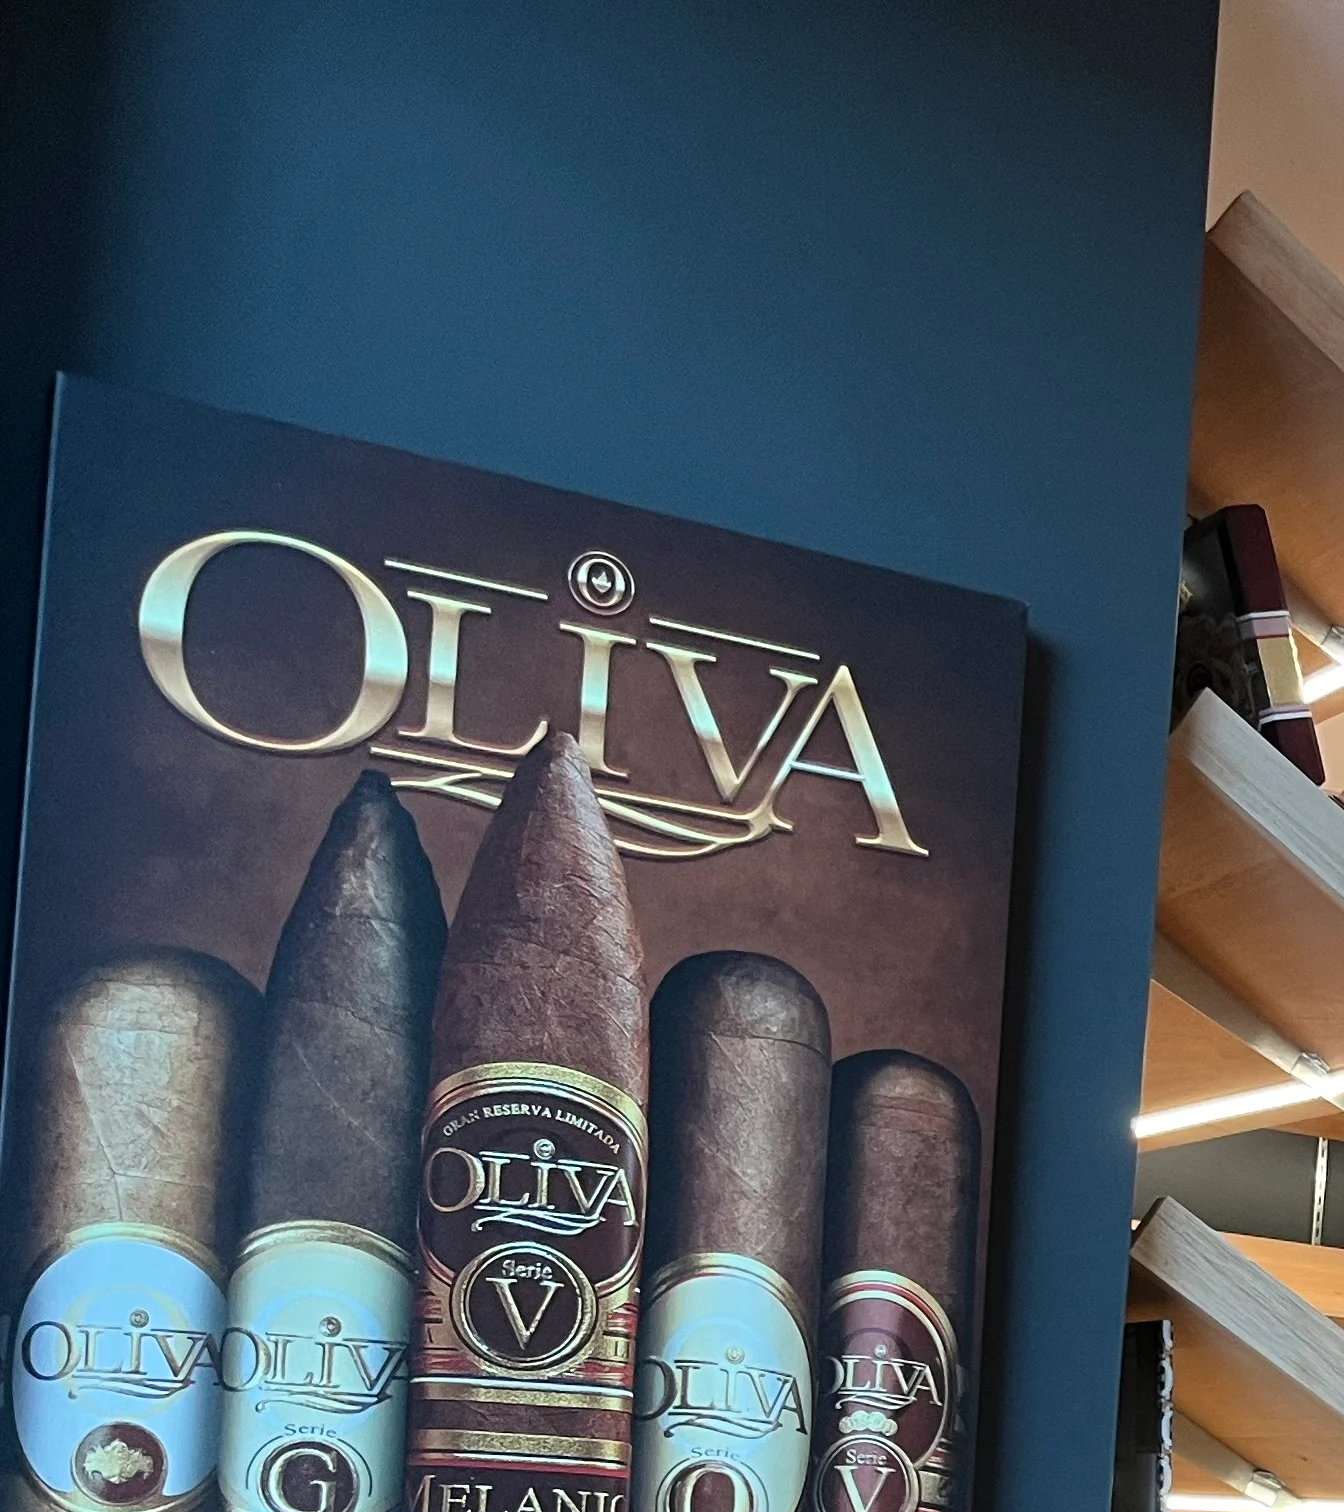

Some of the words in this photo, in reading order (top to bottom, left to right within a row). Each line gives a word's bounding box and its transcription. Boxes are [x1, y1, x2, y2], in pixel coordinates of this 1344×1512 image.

[138, 530, 929, 857] OLIVA
[443, 1109, 480, 1137] GRAN
[482, 1103, 552, 1119] RESERVA
[555, 1109, 621, 1154] LIMITADA
[427, 1139, 639, 1228] OLIVA
[502, 1260, 553, 1279] Serie
[485, 1277, 564, 1350] V
[825, 1346, 943, 1409] OLIVA
[284, 1424, 337, 1438] Serie
[690, 1446, 741, 1461] Serie
[846, 1449, 887, 1465] Serie
